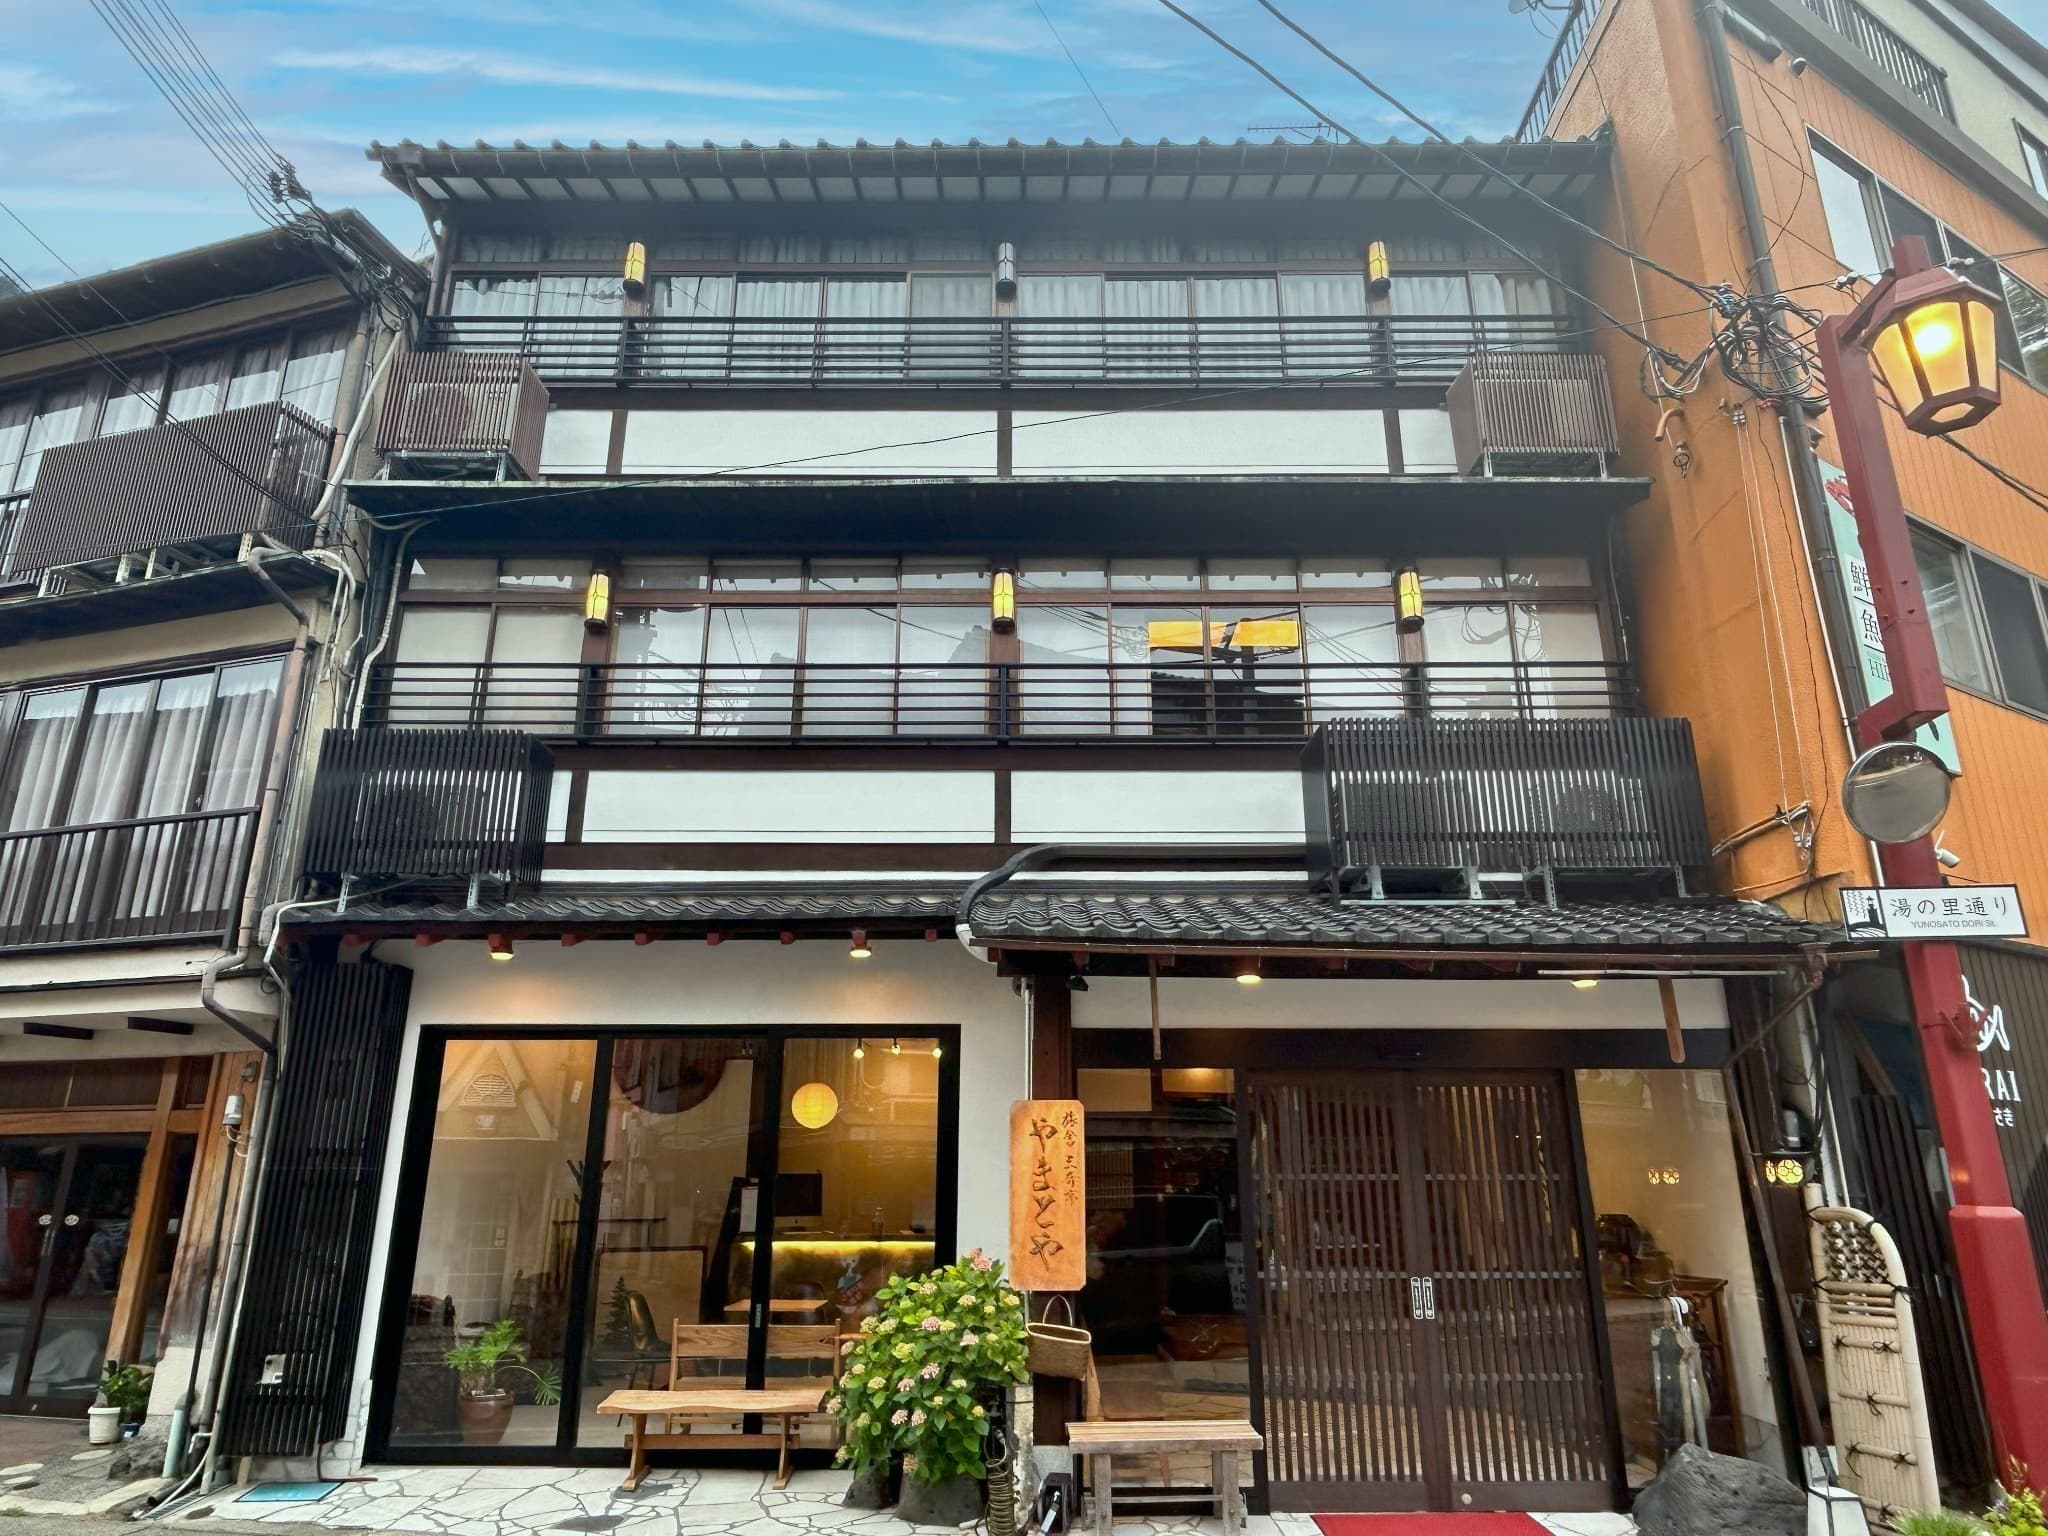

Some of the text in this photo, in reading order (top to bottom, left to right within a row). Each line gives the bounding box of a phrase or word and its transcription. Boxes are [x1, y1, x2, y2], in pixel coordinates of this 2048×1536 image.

[1890, 896, 2006, 918] 湯の里通り
[1912, 920, 1960, 929] YUNOSATO
[1962, 920, 1984, 928] DORI
[1029, 1117, 1064, 1272] やまとや
